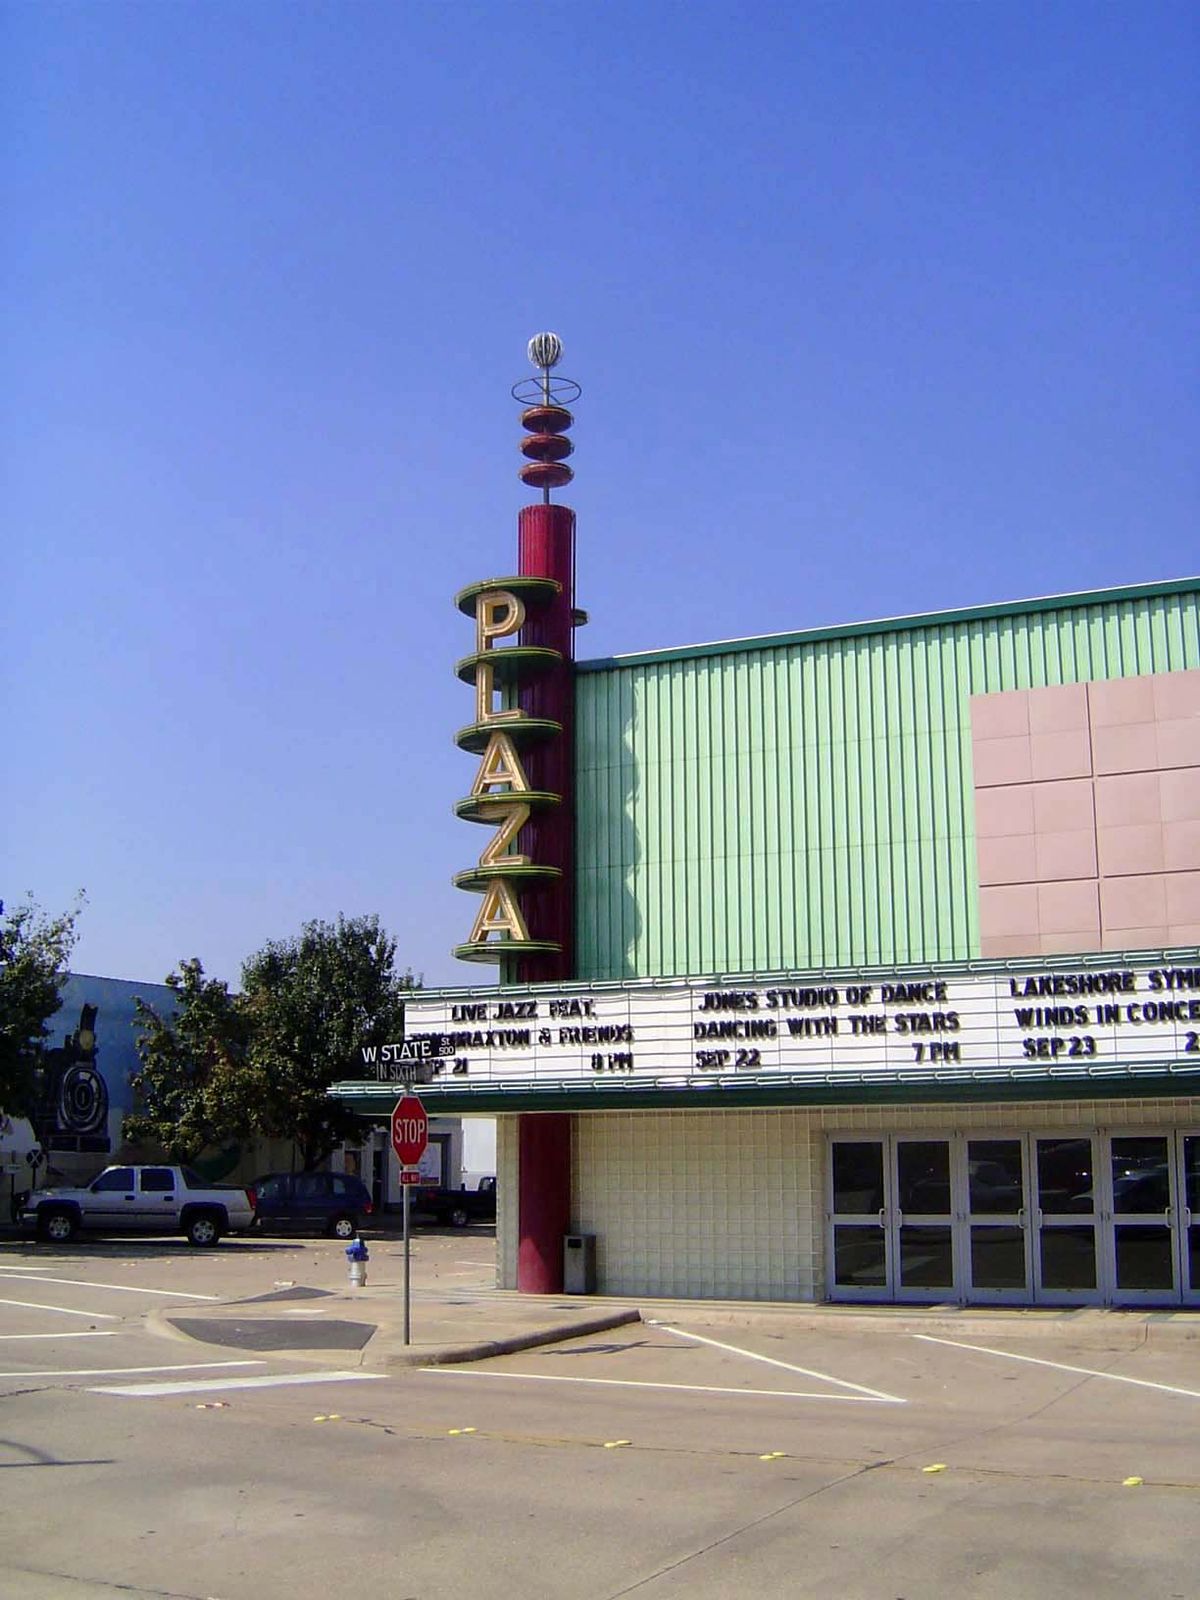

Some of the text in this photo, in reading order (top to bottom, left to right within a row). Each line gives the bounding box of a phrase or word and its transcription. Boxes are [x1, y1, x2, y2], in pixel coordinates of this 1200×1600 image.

[470, 589, 531, 943] PLAZA
[698, 981, 948, 1011] JONES STUDIO OF DANCE
[1010, 971, 1136, 998] LAKESHORE
[452, 1003, 487, 1021] LIVE
[494, 1000, 538, 1020] JAZZ
[1014, 1005, 1089, 1027] WINDS
[1096, 1003, 1120, 1025] IN
[539, 1027, 551, 1045] &
[559, 1024, 633, 1044] FRIENDS
[694, 1010, 960, 1039] DANCING WITH THE STARS
[361, 1046, 377, 1063] W
[381, 1040, 432, 1061] STATE
[439, 1046, 455, 1056] 500
[695, 1041, 960, 1068] SEP 22 7 PM
[1023, 1037, 1064, 1058] SEP
[1069, 1035, 1096, 1056] 23
[379, 1063, 387, 1080] N
[390, 1064, 417, 1081] SIXTH
[395, 1118, 425, 1144] STOP
